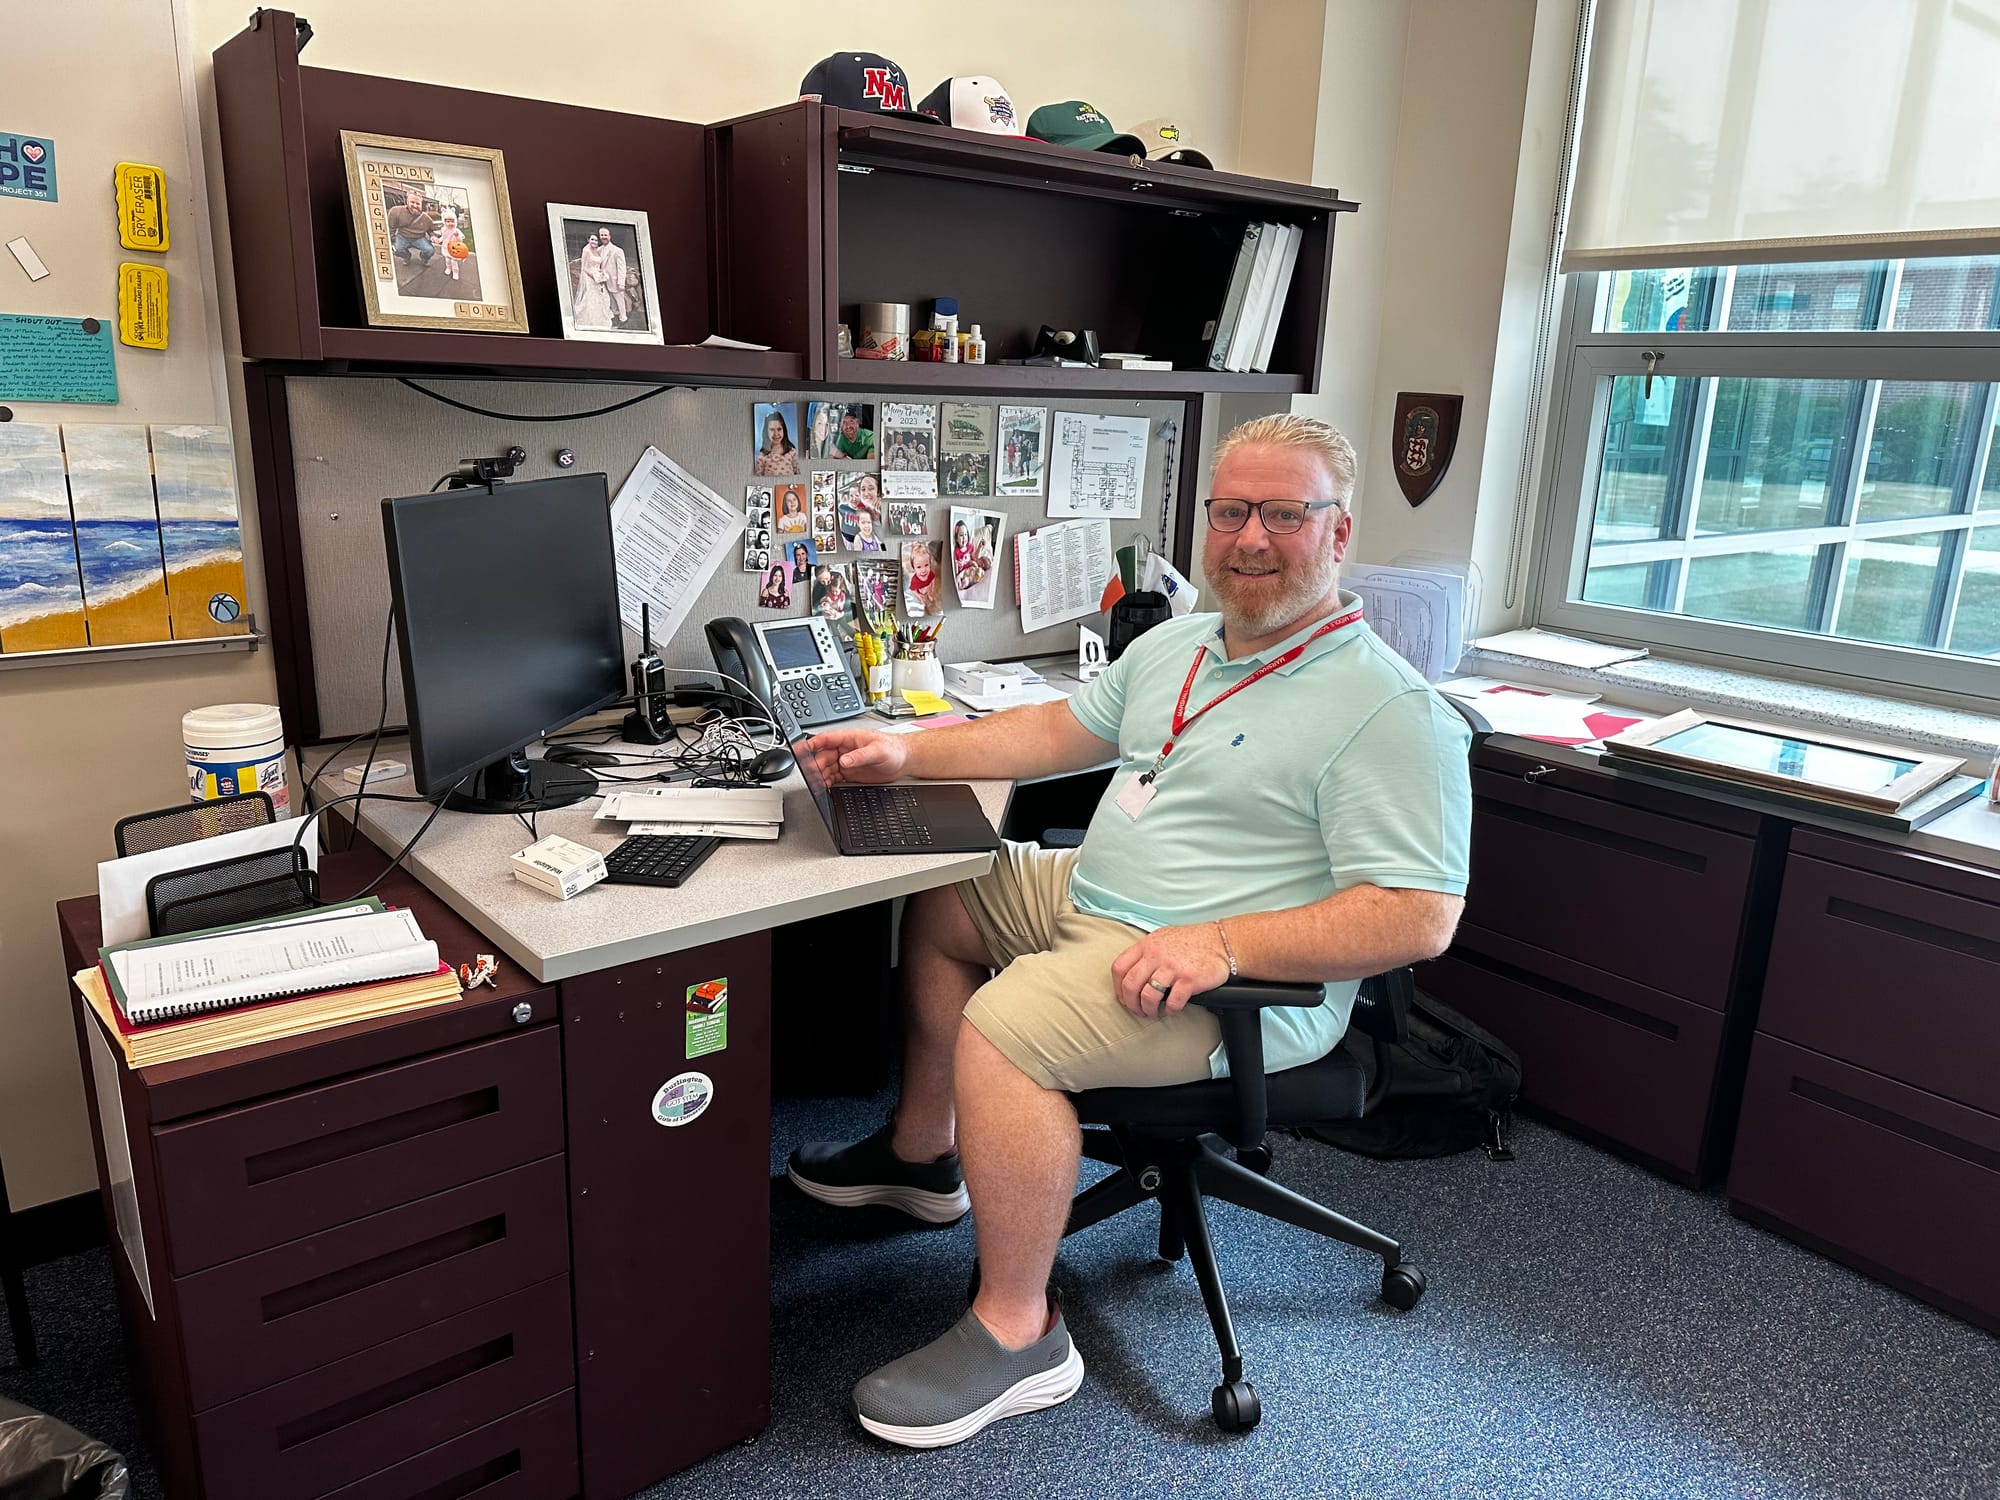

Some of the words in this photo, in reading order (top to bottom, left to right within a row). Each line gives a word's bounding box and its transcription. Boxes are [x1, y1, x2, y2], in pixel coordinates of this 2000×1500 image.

[864, 67, 905, 110] NM
[368, 164, 432, 178] DADDY
[0, 186, 32, 196] PROJECT
[133, 175, 144, 214] ERASER
[137, 215, 147, 237] DRY
[459, 303, 505, 316] LOVE
[15, 317, 43, 325] SHOUT
[900, 417, 918, 425] 2023
[1256, 656, 1286, 680] MARSHALL
[1176, 687, 1190, 718] MARSHALL
[666, 1098, 681, 1108] GOT
[682, 1093, 699, 1103] STEM
